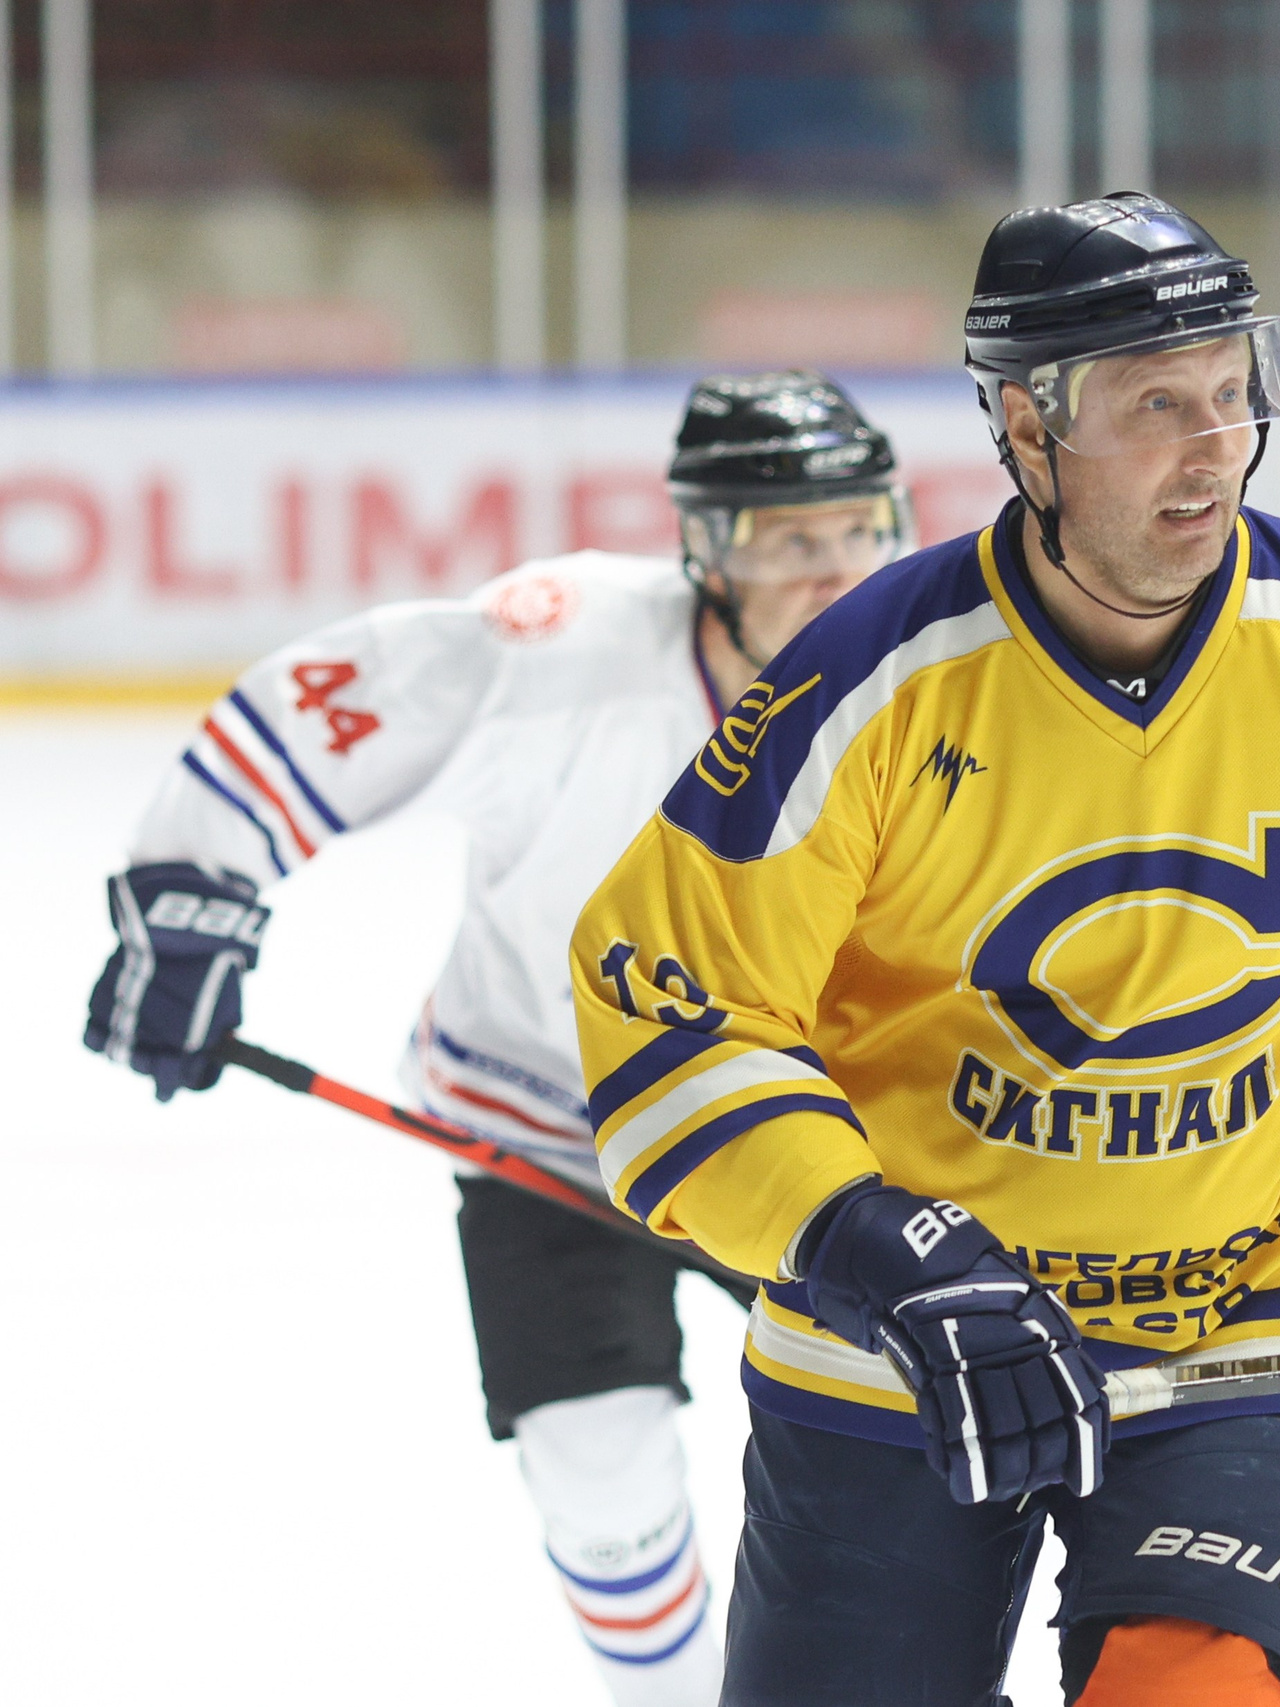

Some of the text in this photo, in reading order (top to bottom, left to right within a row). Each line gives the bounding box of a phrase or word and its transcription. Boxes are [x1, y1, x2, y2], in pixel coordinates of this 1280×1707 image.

[1156, 275, 1229, 301] BAUER
[965, 314, 1011, 330] BAUER
[291, 660, 382, 757] 44
[948, 1045, 1280, 1163] СИГНАЛ
